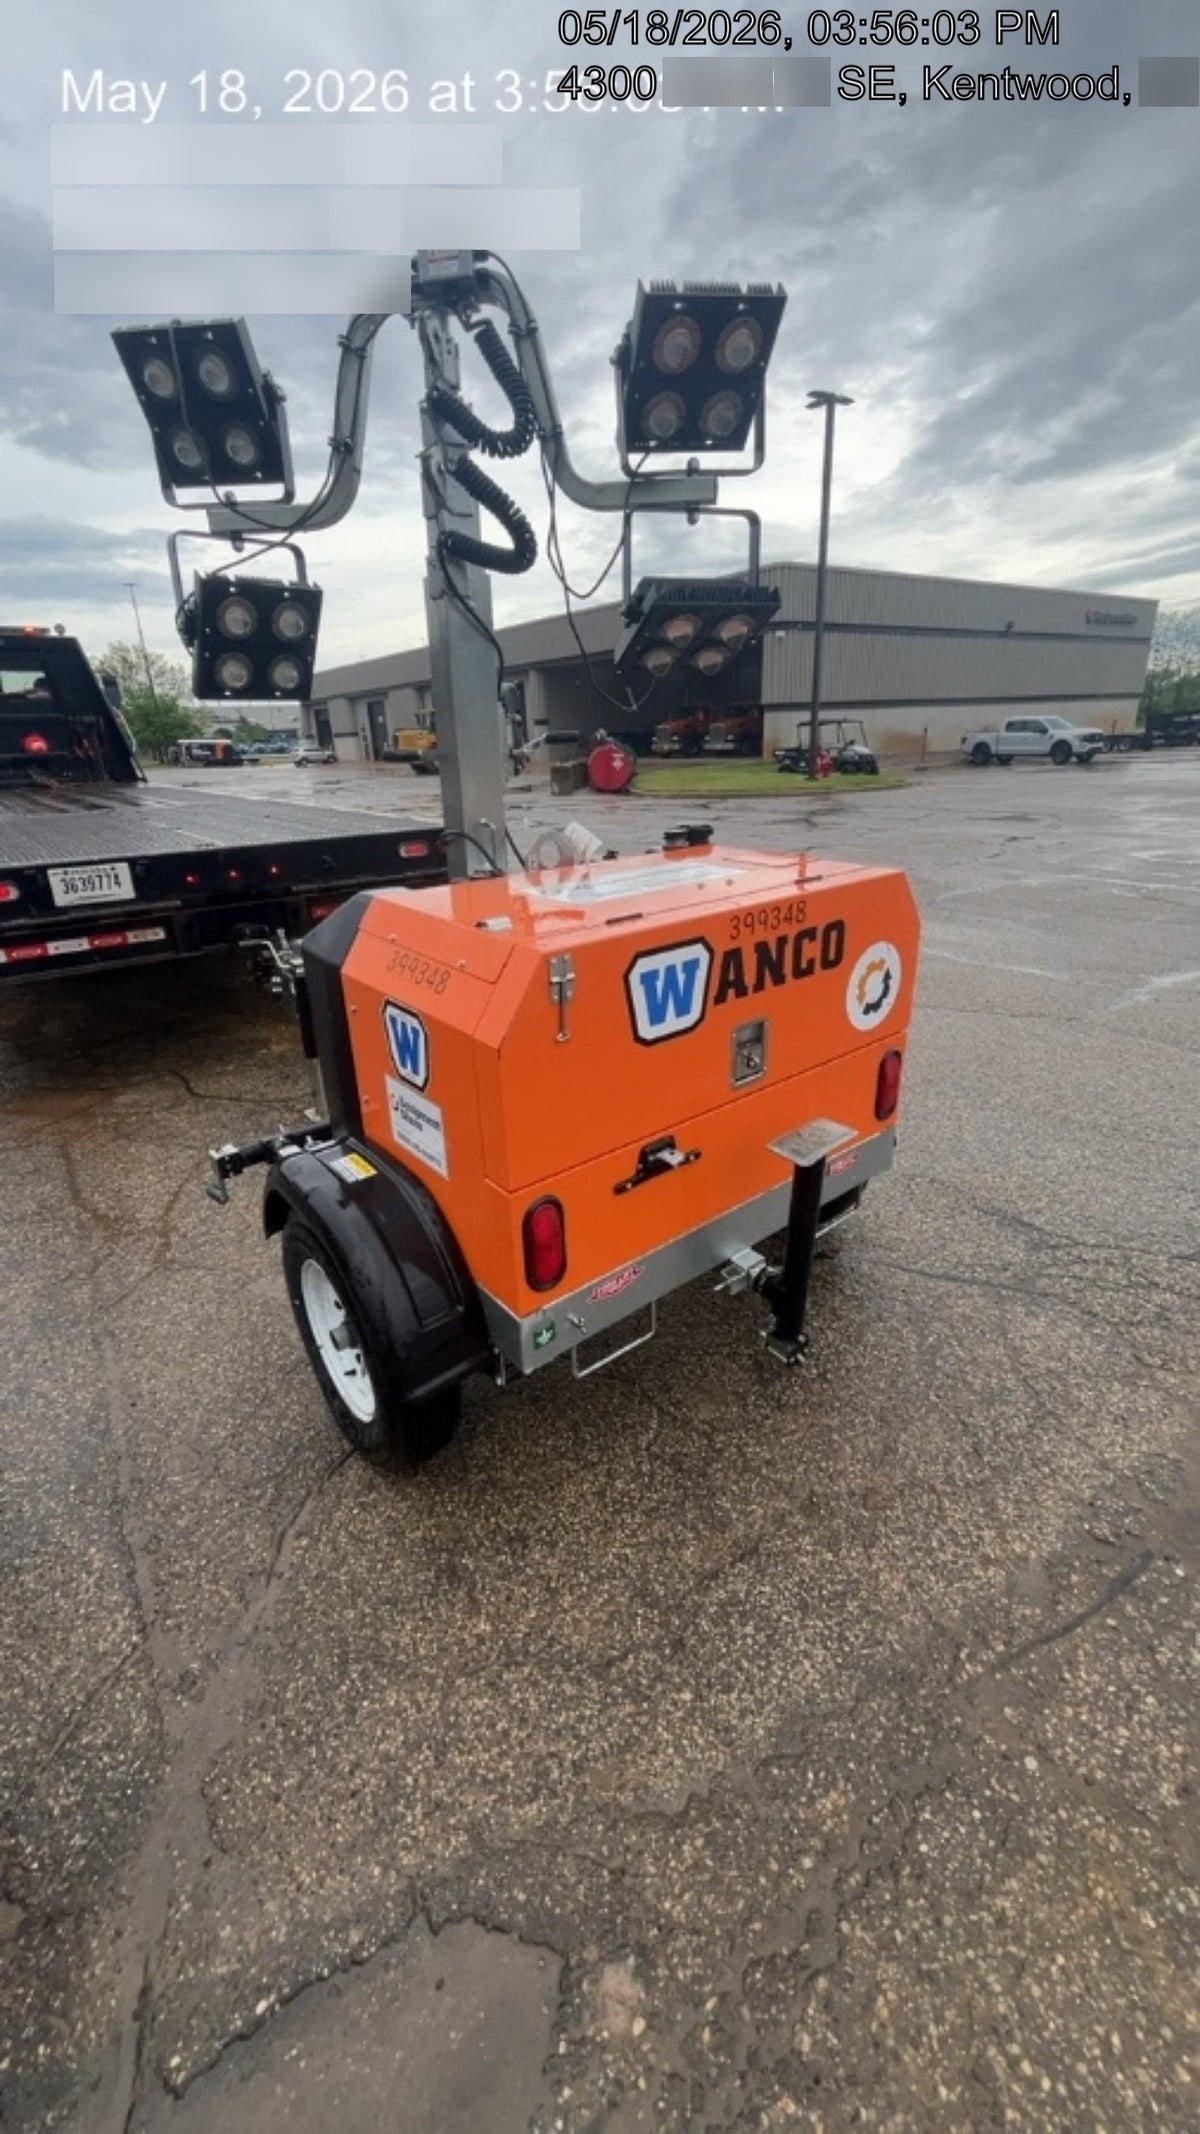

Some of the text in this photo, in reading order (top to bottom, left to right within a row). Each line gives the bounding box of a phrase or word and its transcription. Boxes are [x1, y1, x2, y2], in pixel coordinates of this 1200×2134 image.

[729, 900, 808, 941] 399348
[386, 950, 452, 995] 399348
[638, 918, 846, 1028] WANCO
[388, 1013, 421, 1077] W
